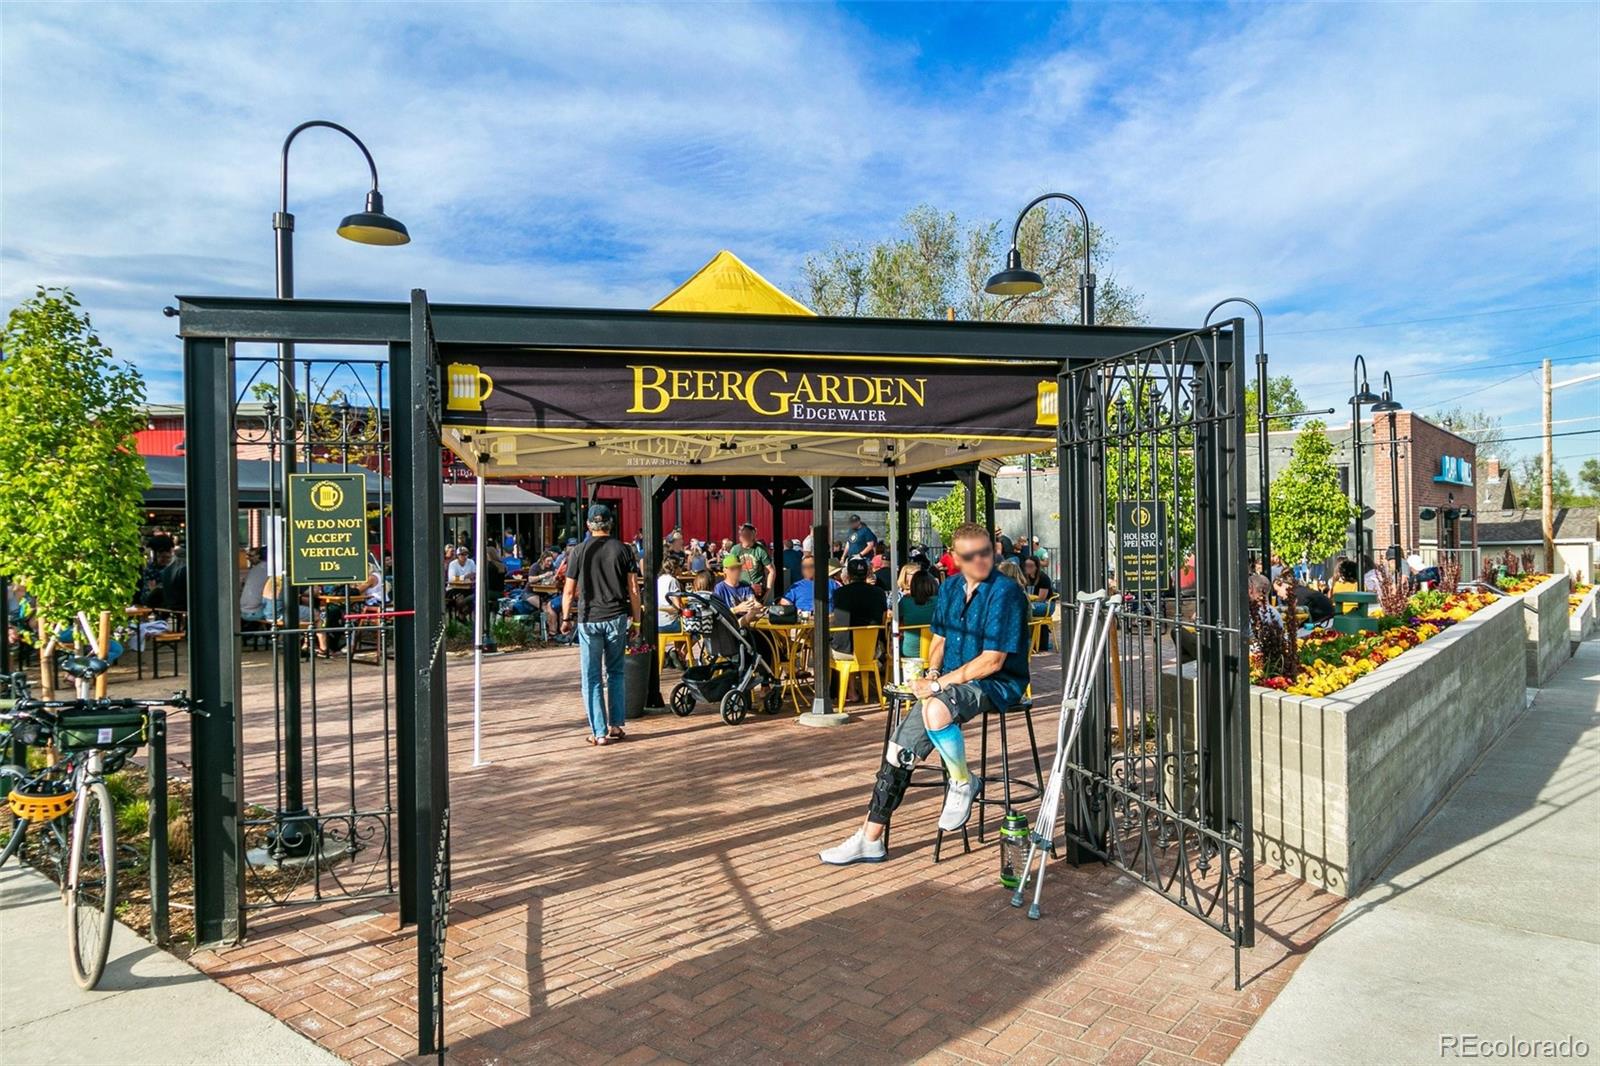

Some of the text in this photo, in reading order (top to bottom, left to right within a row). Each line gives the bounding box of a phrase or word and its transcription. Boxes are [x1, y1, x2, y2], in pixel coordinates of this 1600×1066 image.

[793, 404, 887, 421] EDGEWATER
[295, 519, 362, 529] WE DO NOT
[306, 533, 352, 543] ACCEPT
[300, 547, 359, 557] VERTICAL
[320, 561, 340, 571] ID's
